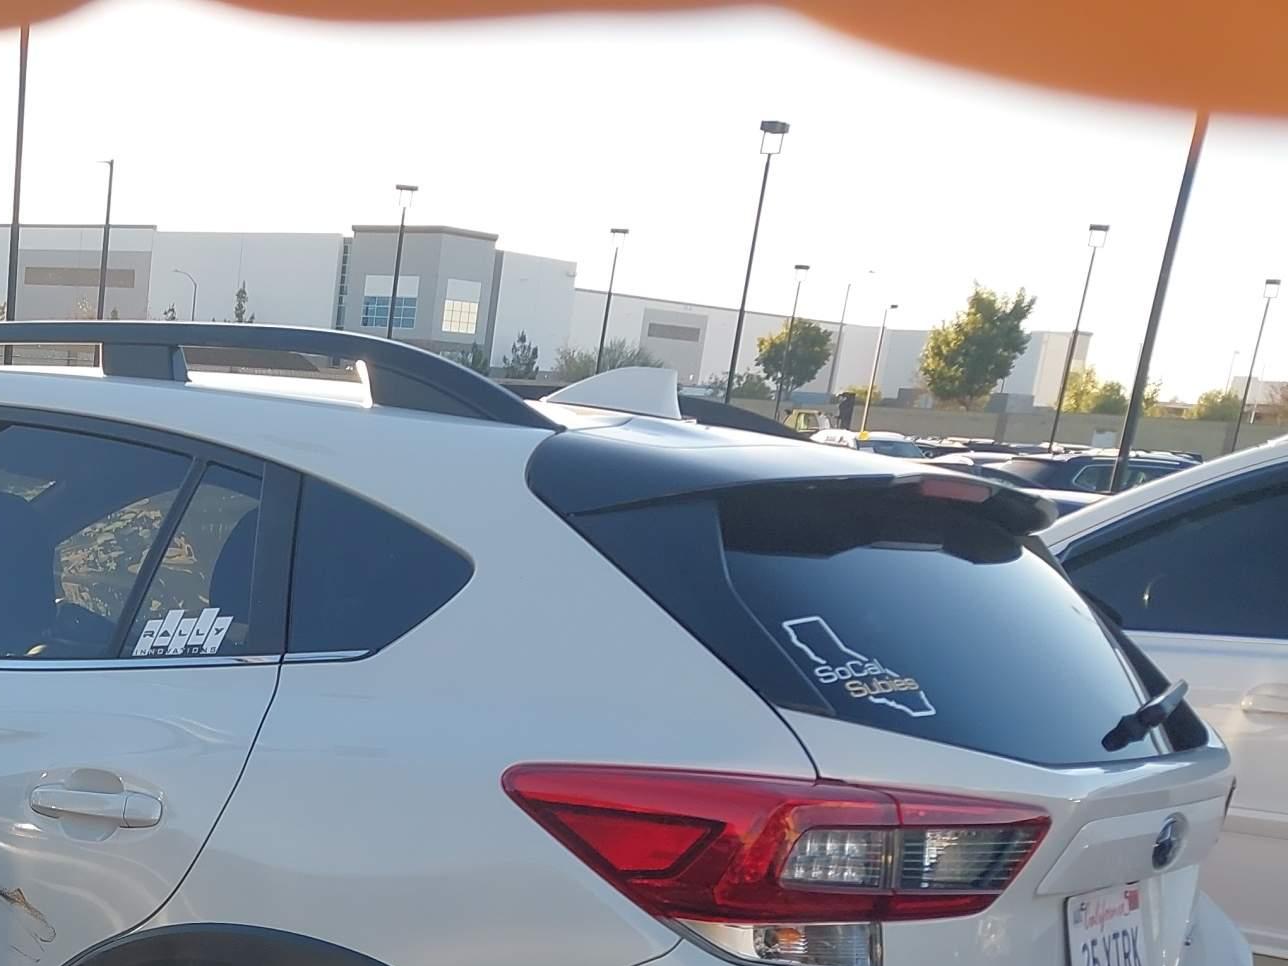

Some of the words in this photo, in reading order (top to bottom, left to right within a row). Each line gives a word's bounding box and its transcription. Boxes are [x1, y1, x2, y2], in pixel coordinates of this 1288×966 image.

[142, 627, 224, 638] RALLY
[814, 658, 887, 683] SoCal
[845, 676, 919, 698] Subies
